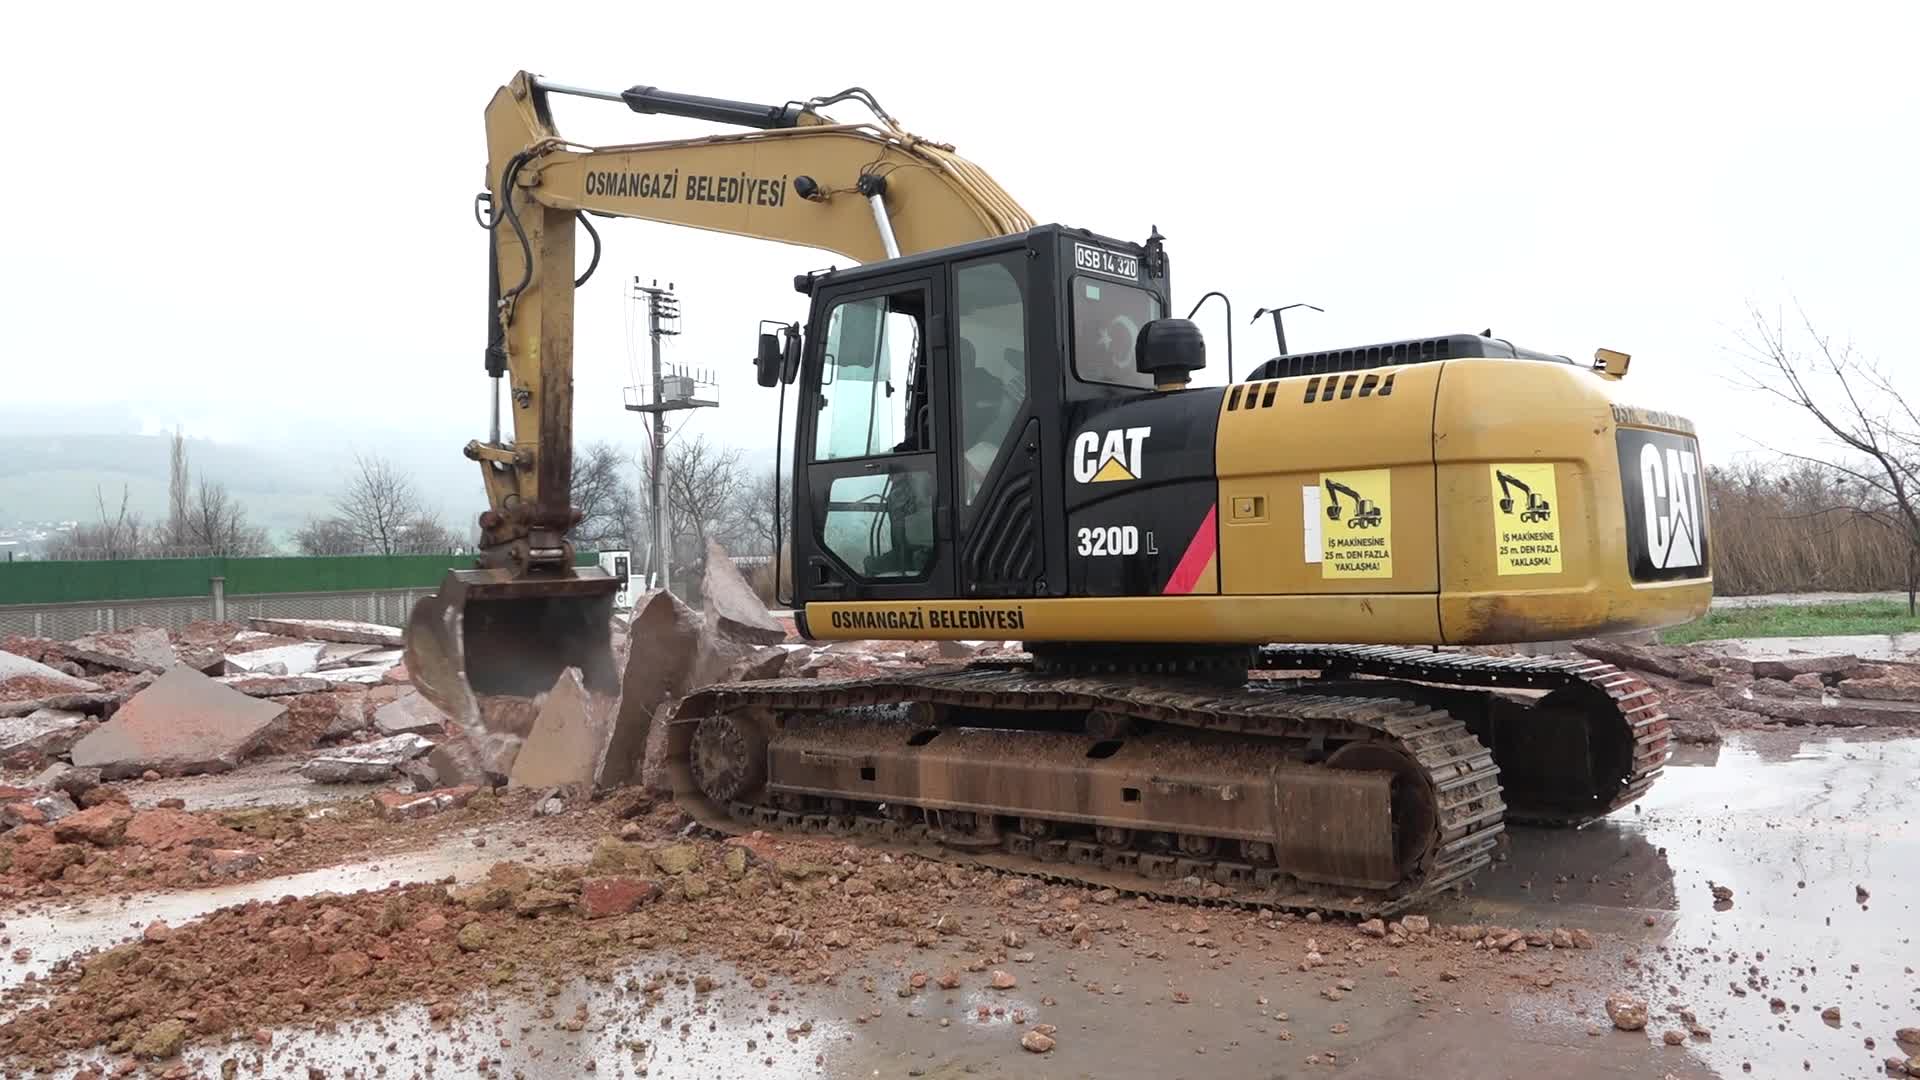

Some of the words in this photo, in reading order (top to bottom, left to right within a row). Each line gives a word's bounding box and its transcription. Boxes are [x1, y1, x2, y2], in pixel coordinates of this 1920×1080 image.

[586, 168, 678, 199] OSMANGAZİ
[686, 172, 787, 207] BELEDİYESİ
[1103, 254, 1114, 272] 14
[1116, 257, 1136, 277] 320
[1074, 426, 1151, 484] CAT
[1640, 443, 1702, 569] CAT
[1078, 526, 1138, 556] 320D
[1146, 532, 1158, 554] L
[1337, 536, 1384, 547] MAKİNESİNE
[1512, 531, 1554, 541] MAKİNESİNE
[1325, 552, 1333, 560] 25
[1346, 551, 1363, 559] DEN
[1365, 550, 1389, 559] FAZLA
[1500, 547, 1508, 555] 25
[1537, 545, 1558, 553] FAZLA
[1335, 563, 1380, 572] YAKLAŞMA!
[831, 607, 924, 629] OSMANGAZİ
[929, 605, 1025, 629] BELEDİYESİ
